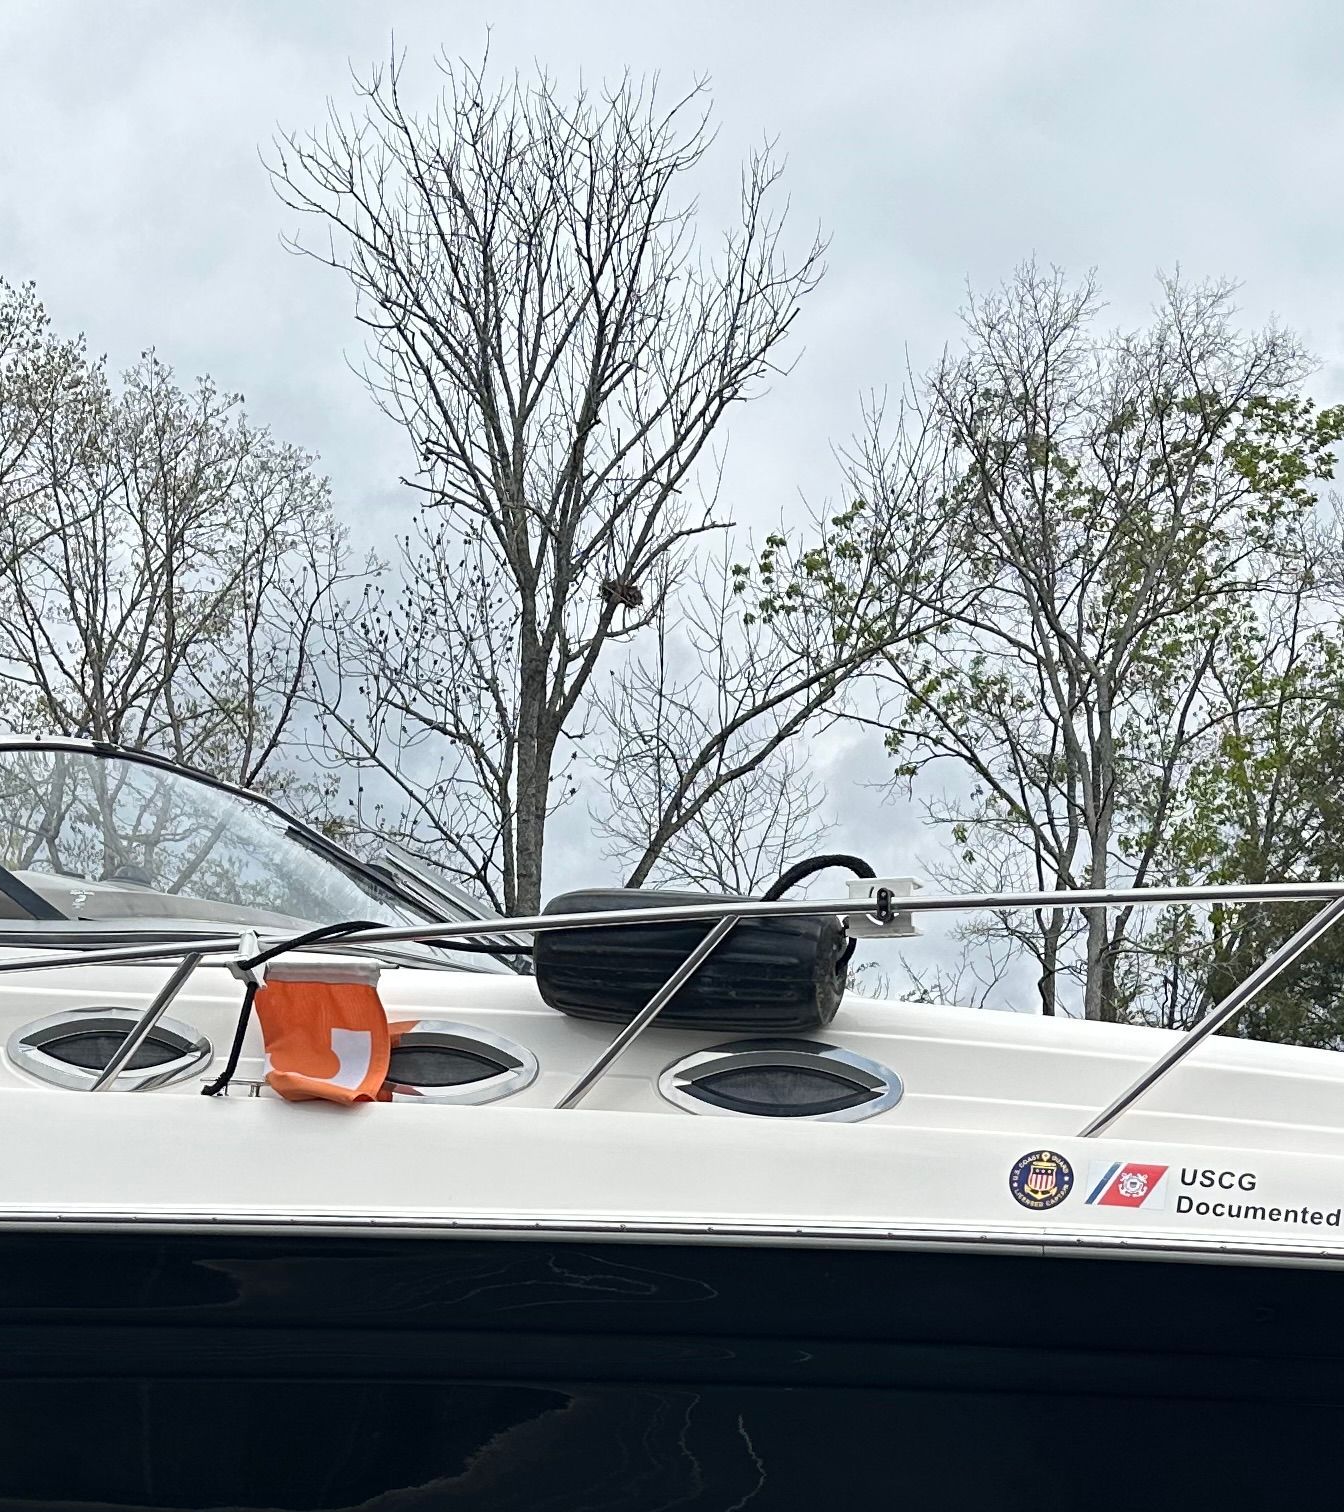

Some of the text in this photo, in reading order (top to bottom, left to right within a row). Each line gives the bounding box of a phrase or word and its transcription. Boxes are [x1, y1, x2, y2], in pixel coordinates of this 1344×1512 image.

[1018, 1153, 1041, 1169] COAST
[1180, 1167, 1257, 1192] USCG
[1176, 1195, 1342, 1227] Documented
